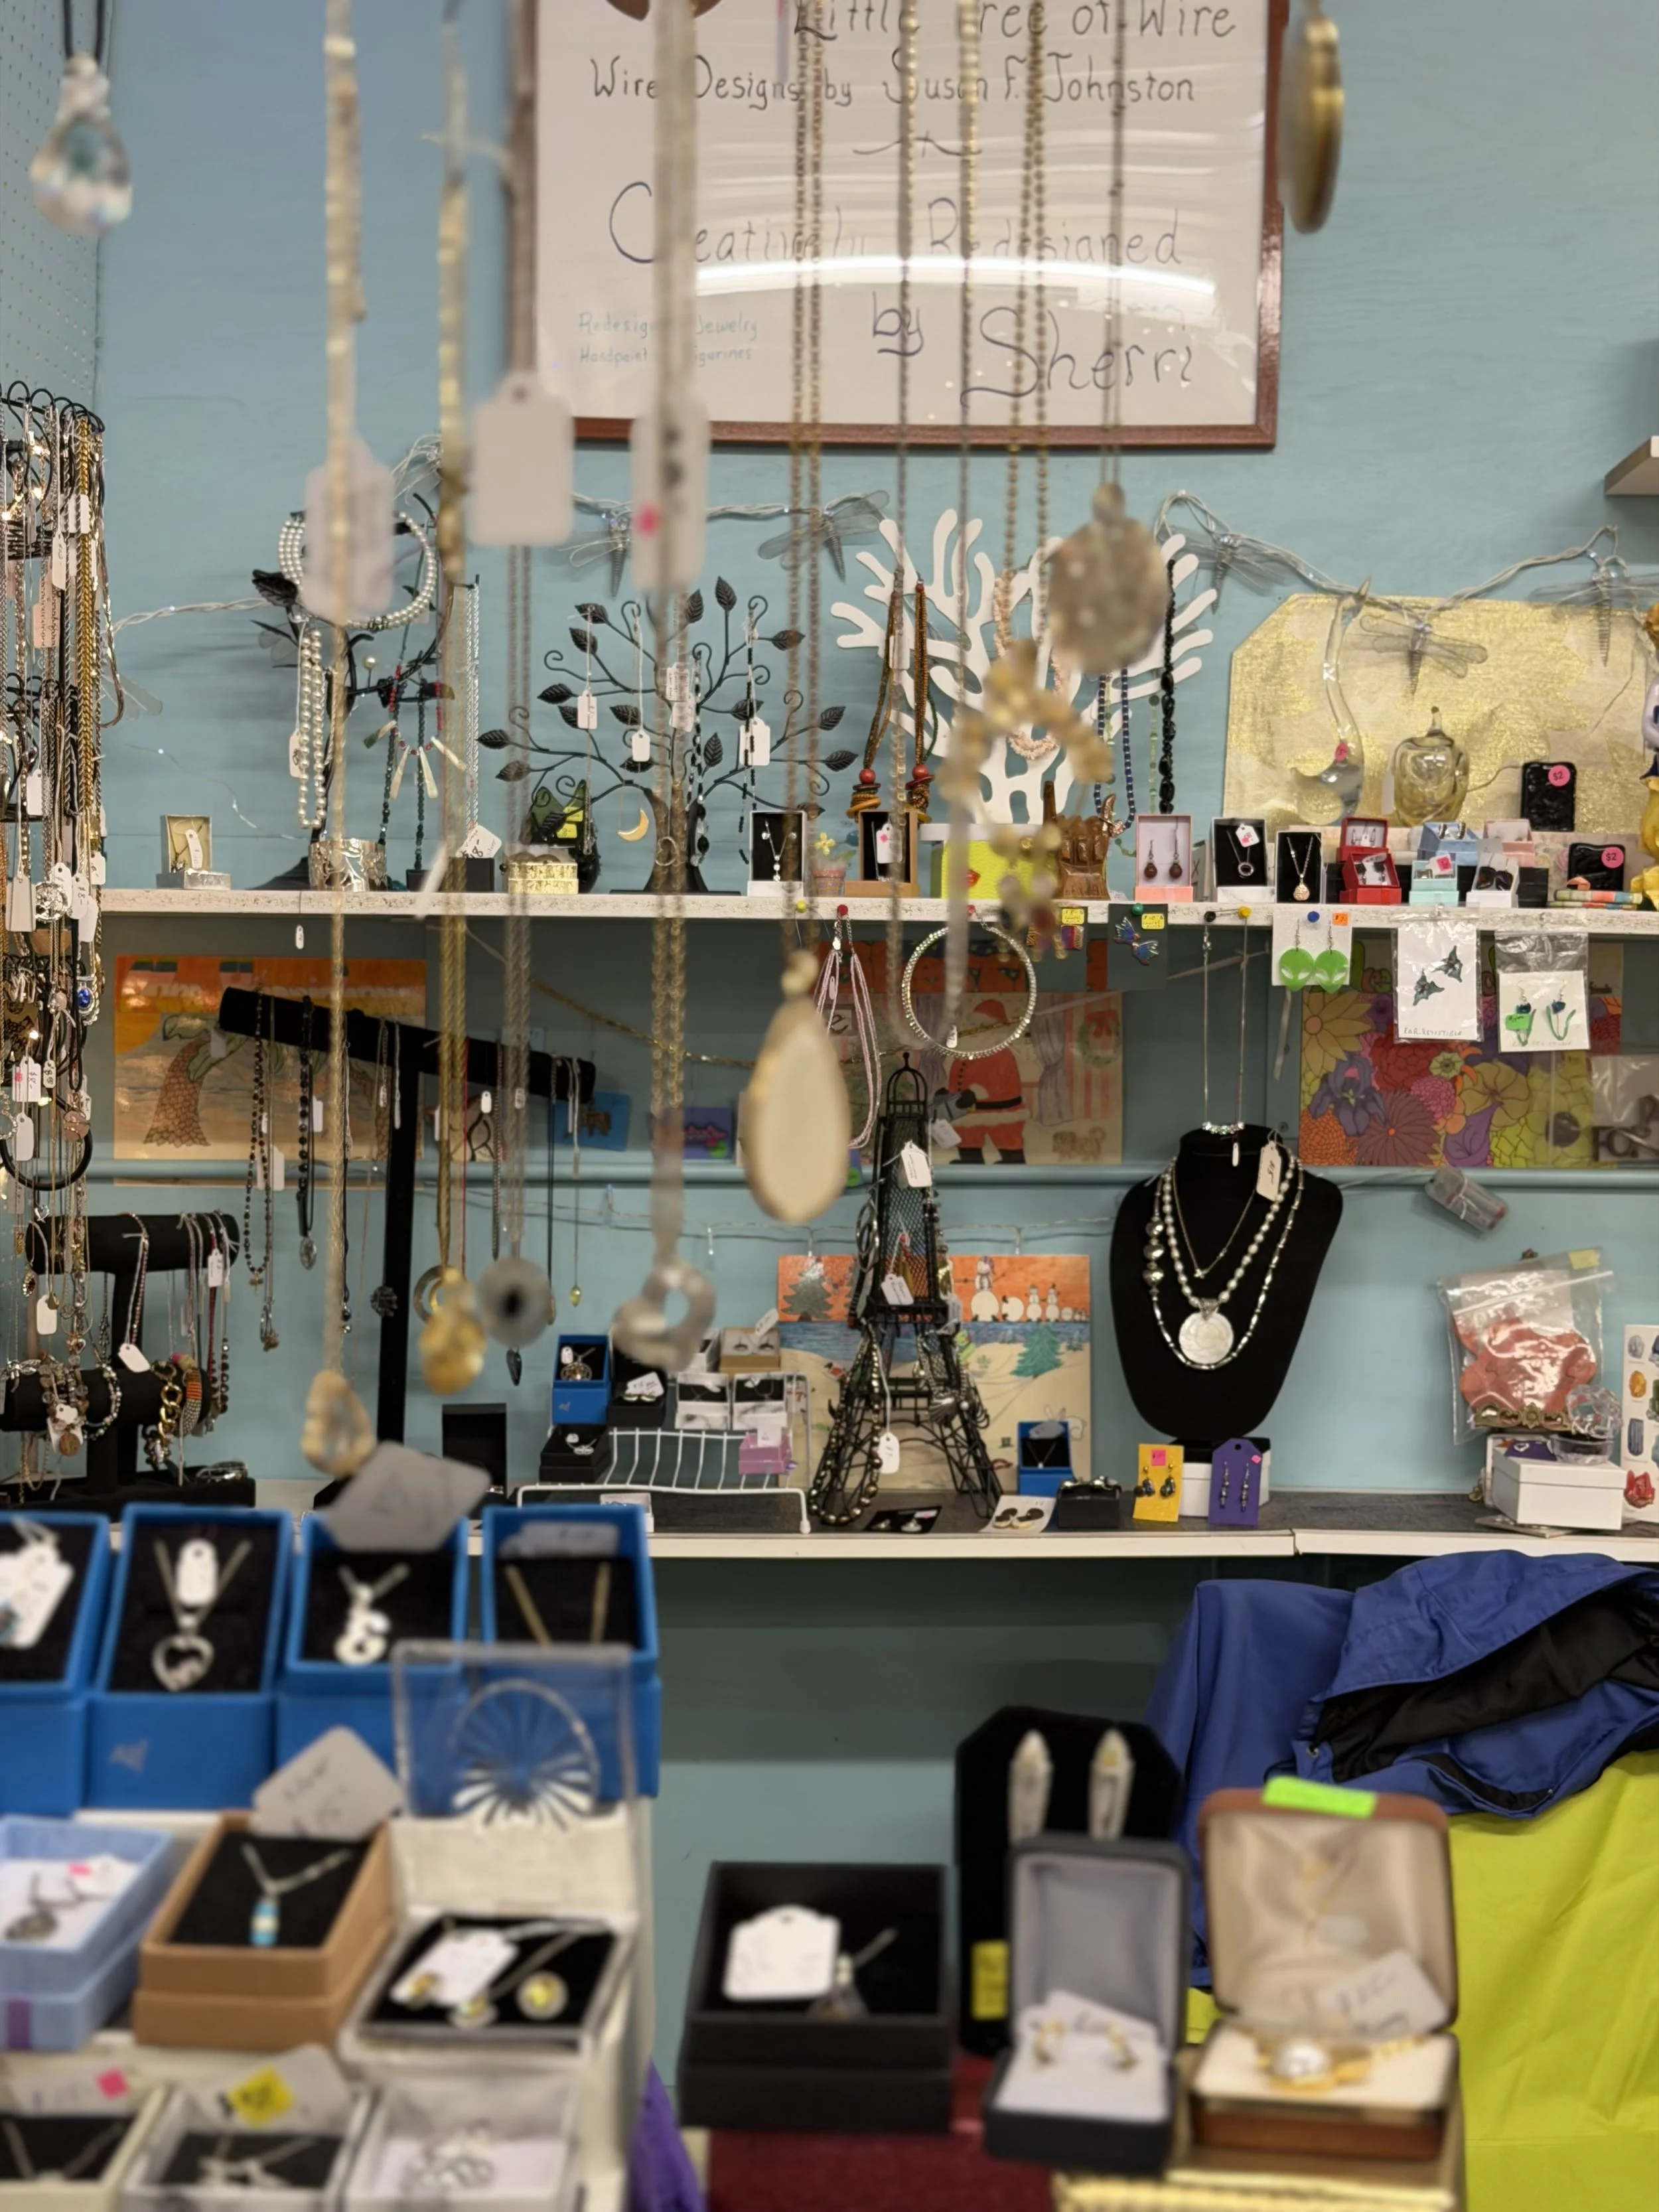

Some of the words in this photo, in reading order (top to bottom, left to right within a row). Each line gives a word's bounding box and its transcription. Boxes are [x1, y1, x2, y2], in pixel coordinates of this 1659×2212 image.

[1140, 0, 1236, 37] Wire
[590, 55, 657, 99] Wire
[824, 67, 852, 107] by
[1043, 52, 1194, 102] Johnston
[872, 289, 924, 358] by
[960, 305, 1192, 409] Sherri
[1552, 771, 1564, 781] $2
[1605, 852, 1617, 861] $2
